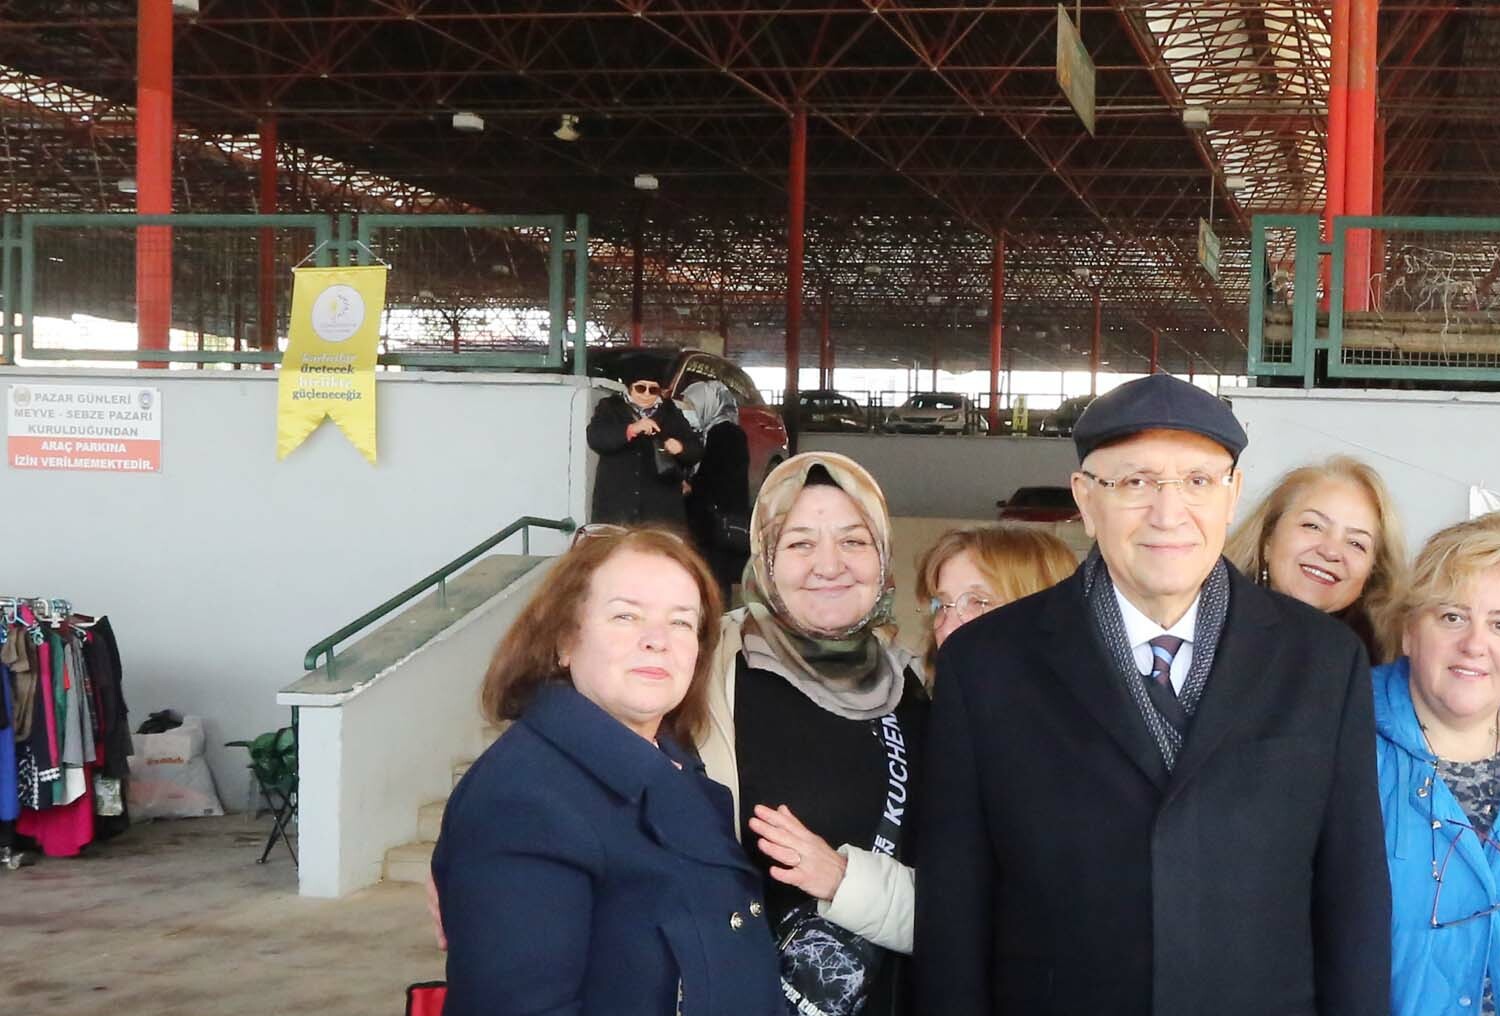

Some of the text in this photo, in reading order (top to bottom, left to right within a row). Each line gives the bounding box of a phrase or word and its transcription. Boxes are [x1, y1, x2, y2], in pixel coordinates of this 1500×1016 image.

[300, 363, 355, 375] üretecek
[34, 392, 132, 405] PAZAR GÜNLERİ
[292, 388, 362, 401] güçleneceğiz
[14, 408, 56, 418] MEYVE
[66, 410, 105, 420] SEBZE
[109, 412, 153, 421] PAZARI
[28, 424, 139, 437] KURULDUĞUNDAN
[40, 441, 127, 453] ARAÇ PARKINA
[15, 456, 38, 466] İZİN
